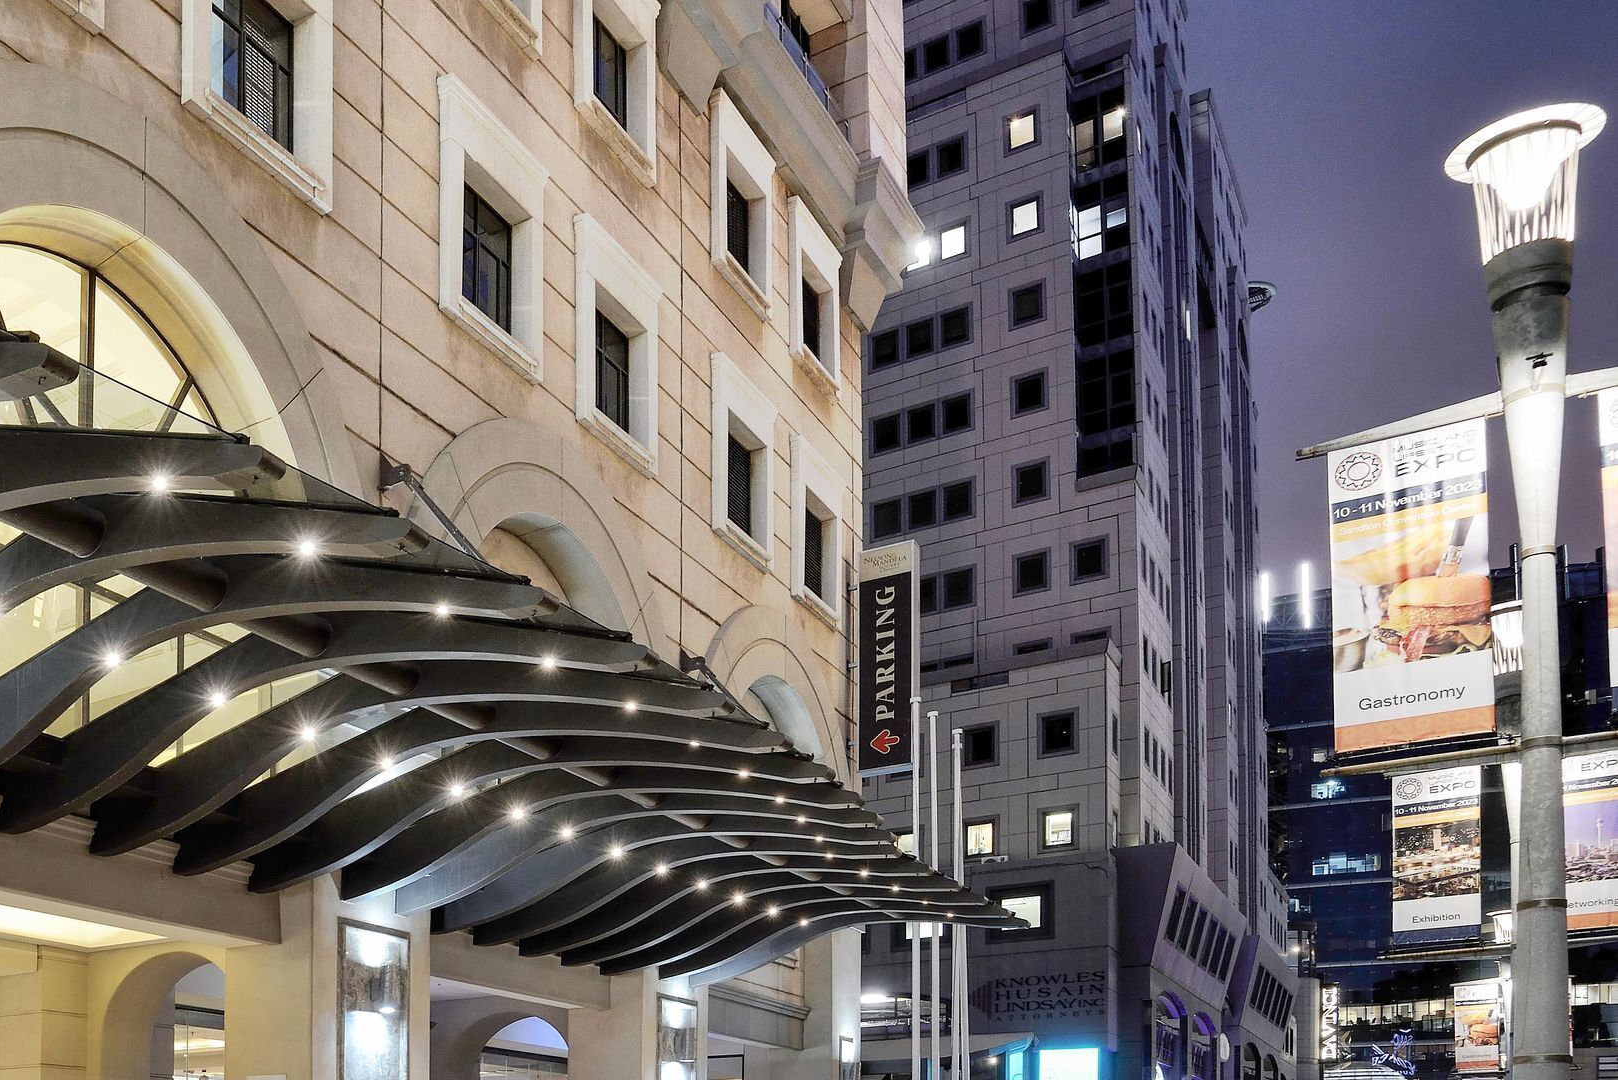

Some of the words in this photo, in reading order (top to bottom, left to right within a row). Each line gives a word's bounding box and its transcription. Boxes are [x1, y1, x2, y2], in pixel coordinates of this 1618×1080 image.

[1392, 438, 1439, 453] MUSIC
[1394, 448, 1478, 478] EXPO
[1333, 506, 1351, 519] 10
[1358, 503, 1372, 515] 11
[1375, 488, 1443, 511] November
[1445, 480, 1483, 497] 2023
[1339, 521, 1381, 536] Sandton
[1383, 508, 1441, 527] Convention
[875, 585, 896, 723] PARKING
[1358, 686, 1466, 711] Gastronomy
[1581, 759, 1618, 771] EXP
[1429, 780, 1476, 794] EXPO
[1418, 802, 1457, 812] November
[1457, 798, 1479, 807] 2023
[1568, 898, 1618, 909] etworking
[1412, 912, 1461, 924] Exhibition
[995, 971, 1105, 989] KNOWLES
[995, 984, 1105, 1001] HUSAIN
[995, 999, 1076, 1014] LINDSAY
[995, 1010, 1105, 1022] ATTORNEYS
